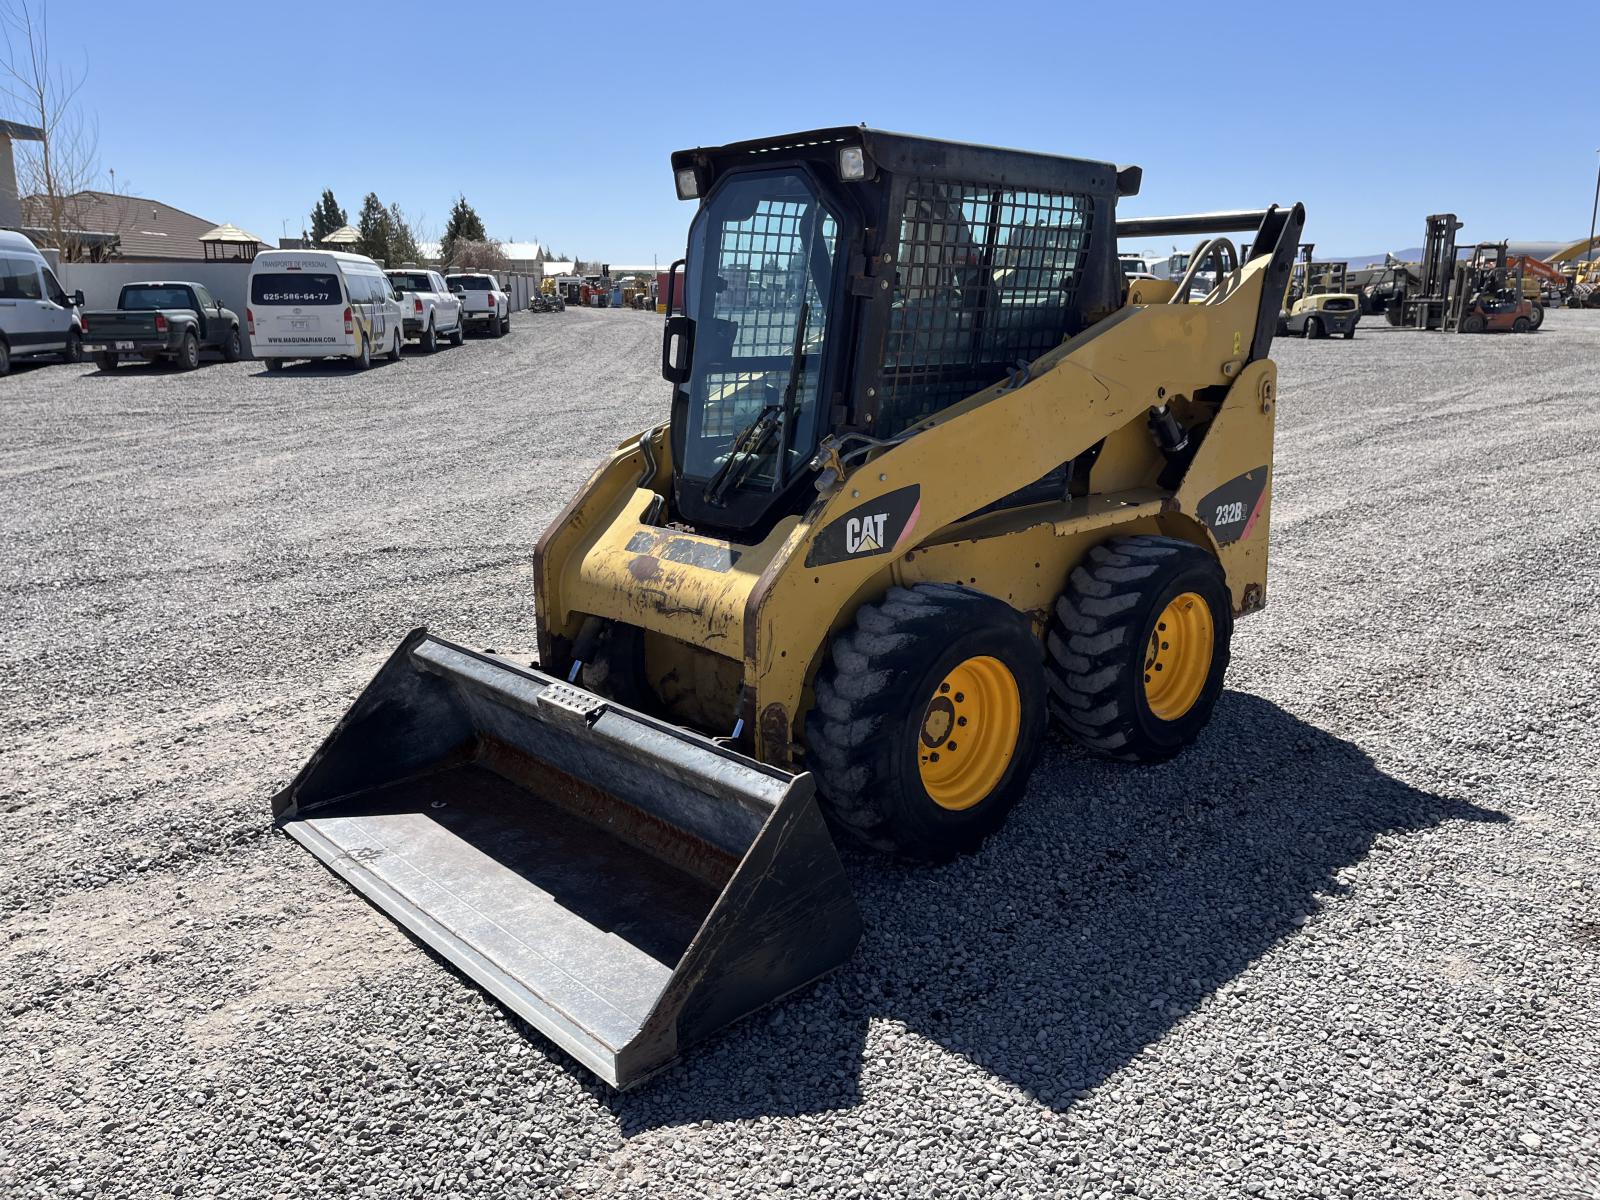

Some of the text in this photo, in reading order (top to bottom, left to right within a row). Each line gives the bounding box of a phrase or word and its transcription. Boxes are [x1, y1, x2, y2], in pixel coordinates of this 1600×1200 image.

[262, 260, 293, 268] TRANSPORTE
[302, 260, 328, 268] PERSONAL
[263, 293, 329, 301] 625-586-64-77
[1215, 502, 1242, 526] 232B
[846, 513, 888, 554] CAT
